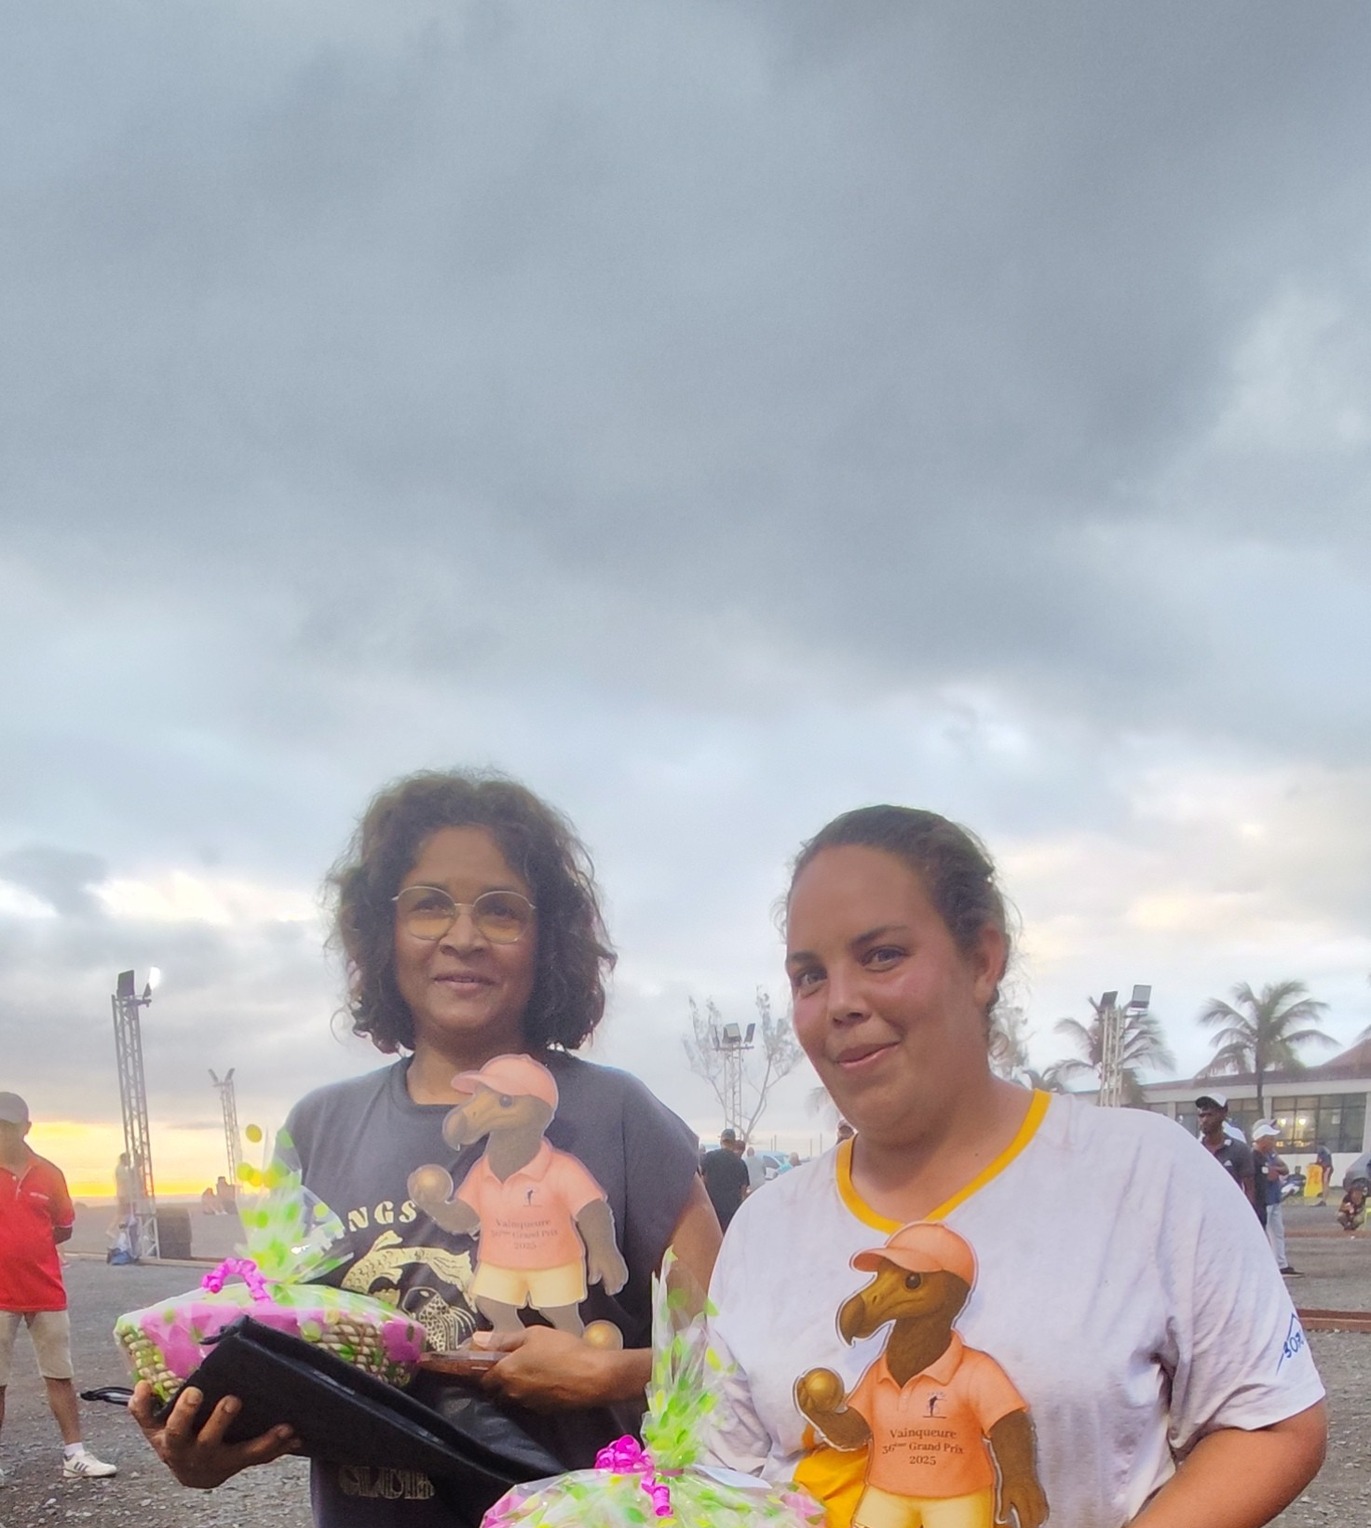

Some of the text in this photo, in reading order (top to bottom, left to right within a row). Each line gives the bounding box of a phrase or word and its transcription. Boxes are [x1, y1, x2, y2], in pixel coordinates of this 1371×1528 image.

[889, 1428, 957, 1439] Vainqueure
[908, 1441, 941, 1452] Grand
[943, 1443, 964, 1455] Prix
[909, 1455, 937, 1466] 2025
